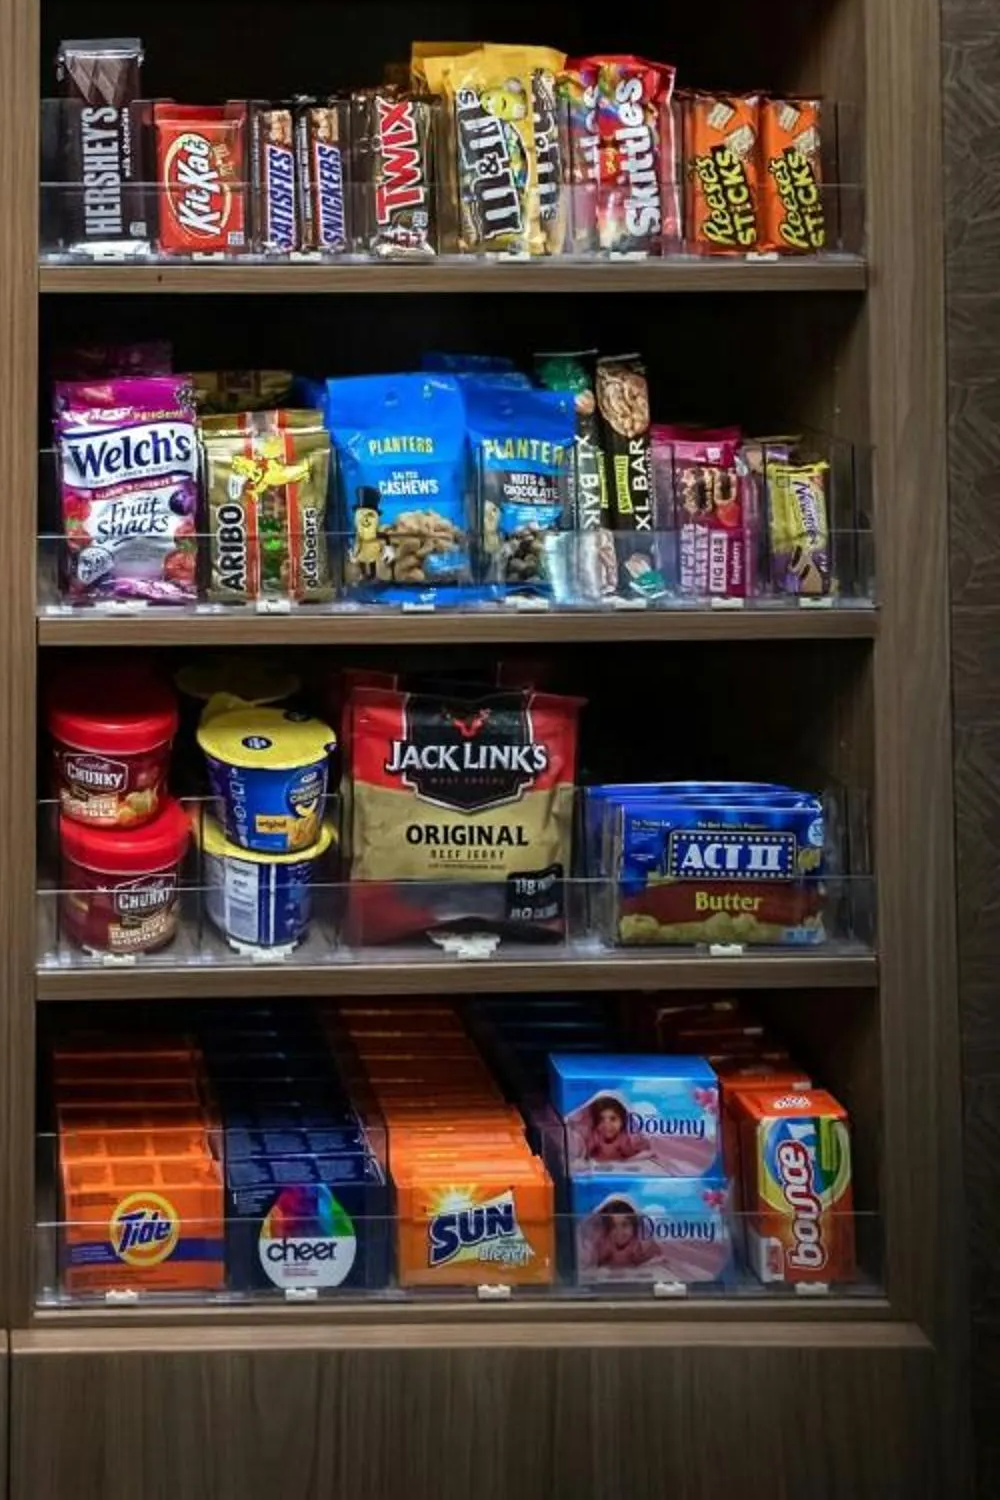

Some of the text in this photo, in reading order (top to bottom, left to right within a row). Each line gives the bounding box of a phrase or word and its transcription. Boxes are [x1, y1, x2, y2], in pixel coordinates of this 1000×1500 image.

[81, 105, 123, 236] HERSHEY'S
[376, 96, 425, 225] TWIX
[615, 77, 661, 237] Skittles
[317, 145, 344, 247] SNICKERS
[68, 430, 191, 478] Welch's
[368, 436, 433, 456] PLANTERS
[378, 478, 440, 495] CASHEWS
[503, 485, 559, 498] CHOCOLATE
[510, 473, 547, 485] NUTS &
[629, 438, 652, 531] XL BAR
[110, 496, 161, 523] Fruit
[579, 473, 601, 530] BAR
[97, 514, 169, 545] Snacks
[712, 538, 724, 588] FIG BAR
[386, 740, 548, 773] JACK LINK'S
[67, 762, 124, 788] CHUNKY
[405, 824, 529, 846] ORIGINAL
[431, 850, 461, 859] BEEF
[681, 843, 783, 870] ACT II
[119, 884, 172, 909] CHUNKY
[695, 891, 764, 911] Butter
[626, 1111, 706, 1139] Downy
[777, 1140, 825, 1268] bounce
[117, 1211, 172, 1252] Tide
[430, 1202, 515, 1265] SUN
[639, 1214, 717, 1243] Downy
[267, 1240, 337, 1262] cheer
